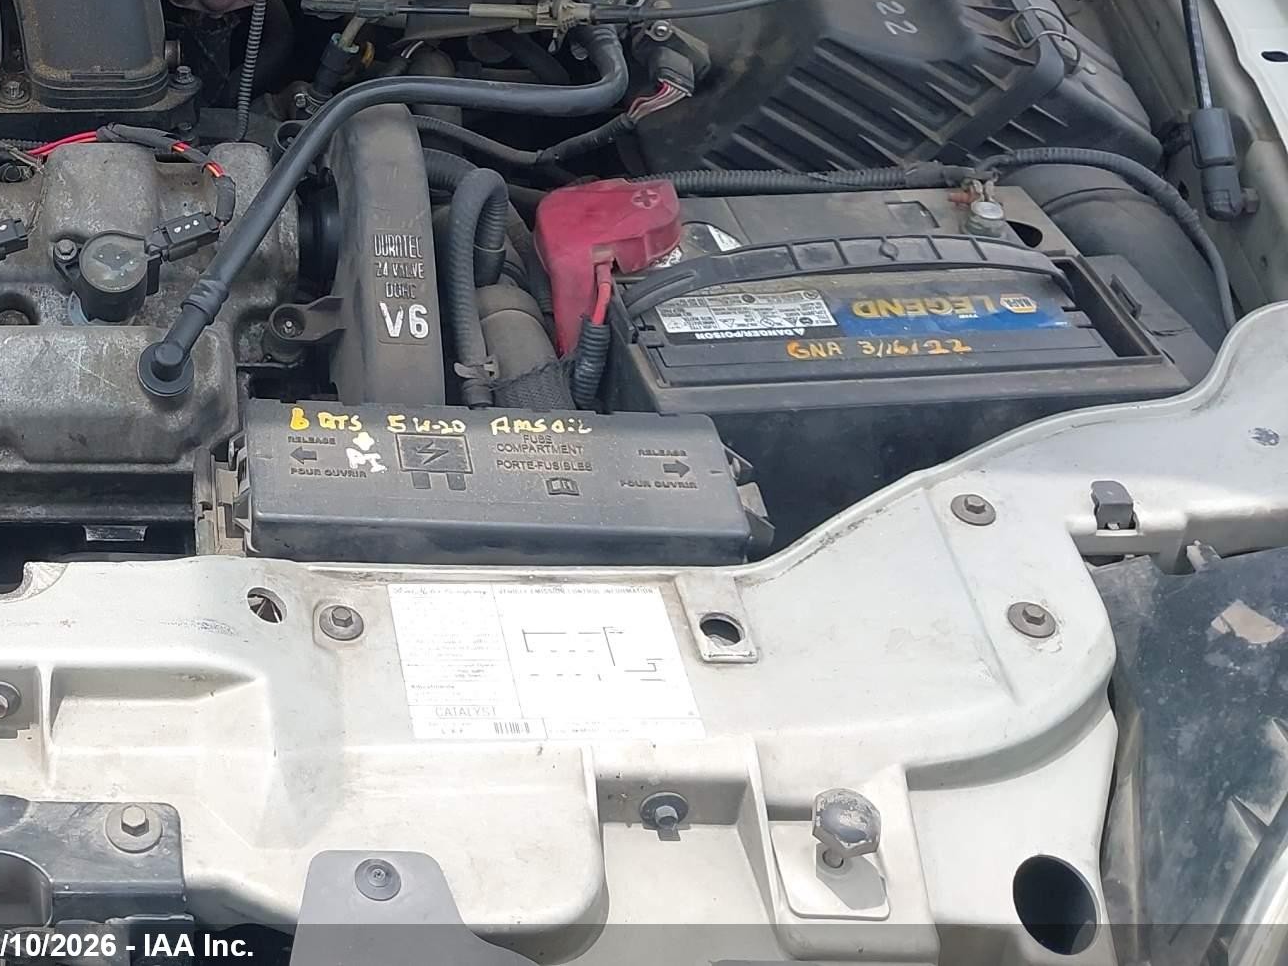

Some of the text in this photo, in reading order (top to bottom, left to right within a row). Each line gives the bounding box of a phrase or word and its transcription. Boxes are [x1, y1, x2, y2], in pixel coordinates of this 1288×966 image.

[374, 234, 423, 259] DURATEC
[376, 262, 425, 279] 24 VALVE
[852, 295, 998, 319] LEGEND
[379, 302, 429, 339] V6
[695, 328, 793, 340] DANGER/POISON
[288, 436, 336, 445] RELEASE
[523, 434, 552, 444] FUSE
[496, 442, 584, 456] COMPARTMENT
[638, 448, 687, 457] RELEASE
[496, 459, 593, 472] PORTE-FUSIBLES
[291, 467, 367, 478] POUR OUVRIR
